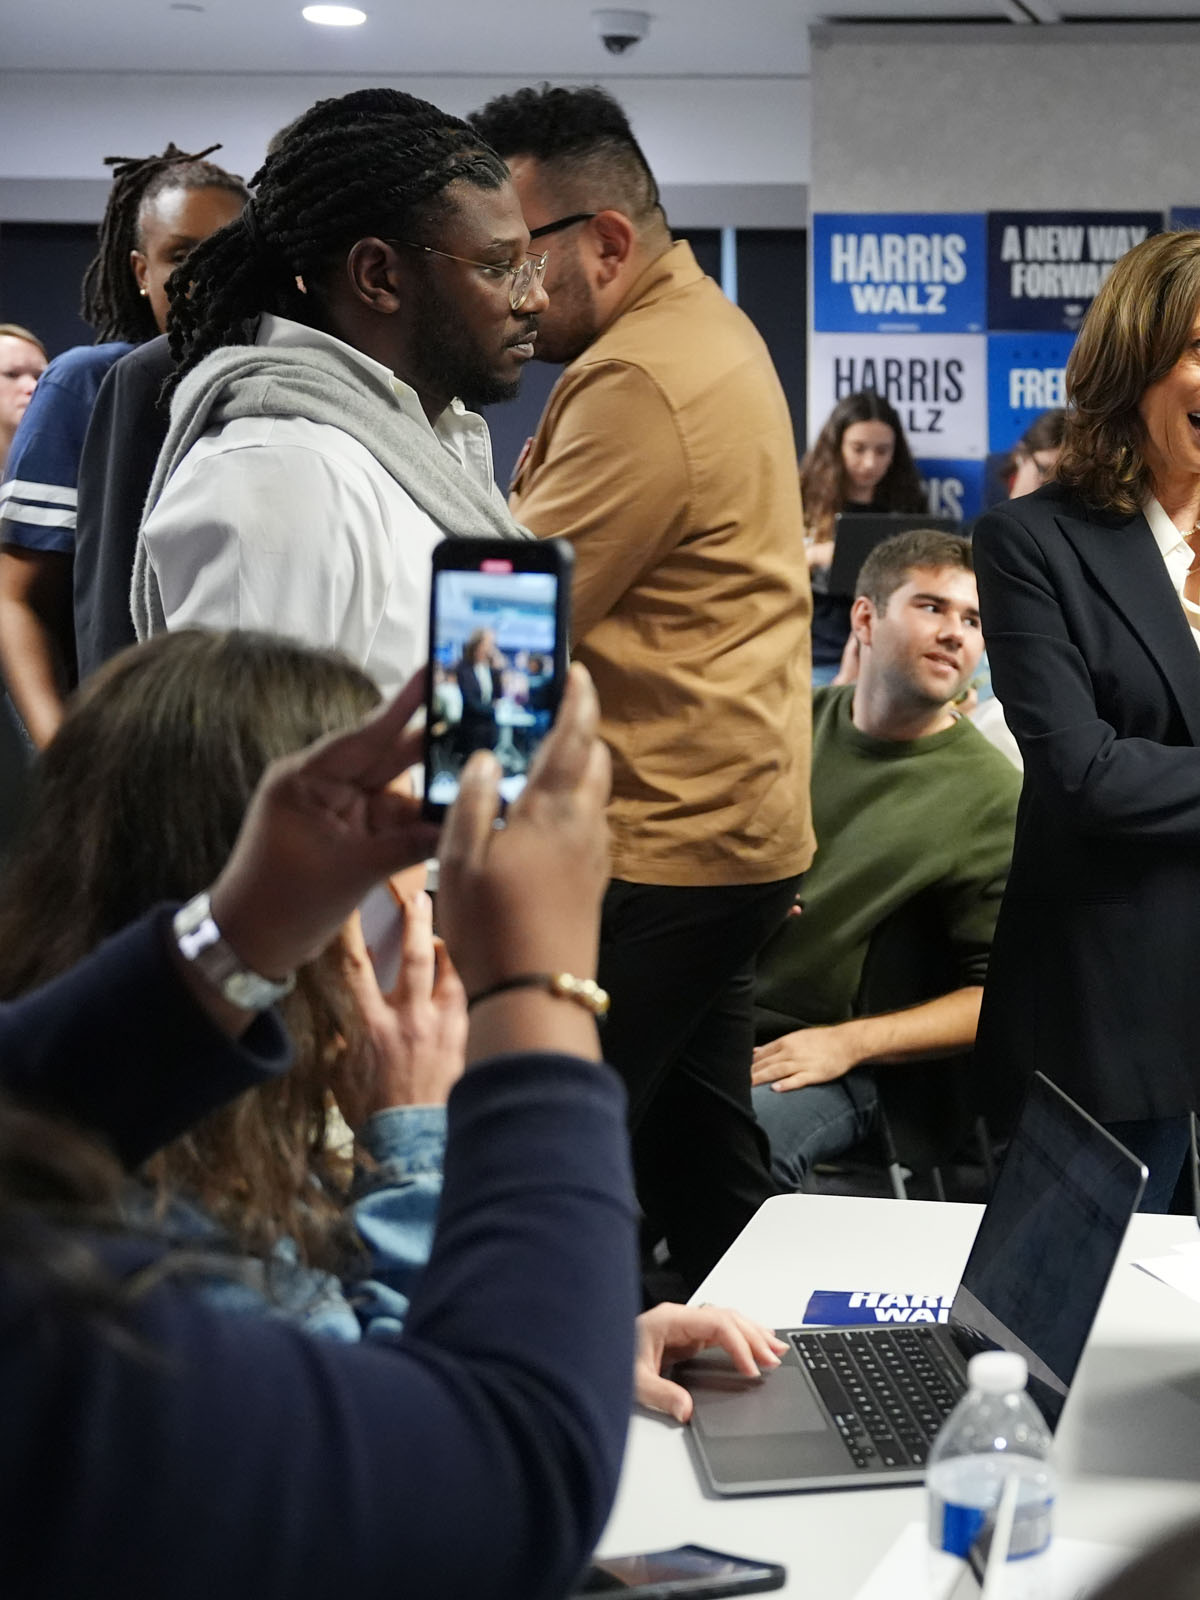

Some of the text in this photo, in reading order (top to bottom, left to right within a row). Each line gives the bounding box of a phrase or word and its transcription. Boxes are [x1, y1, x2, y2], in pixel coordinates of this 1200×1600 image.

[831, 233, 967, 284] HARRIS
[1000, 225, 1022, 261] A
[1024, 225, 1085, 261] NEW
[851, 284, 947, 314] WALZ
[834, 358, 964, 402] HARRIS
[908, 409, 944, 432] LZ
